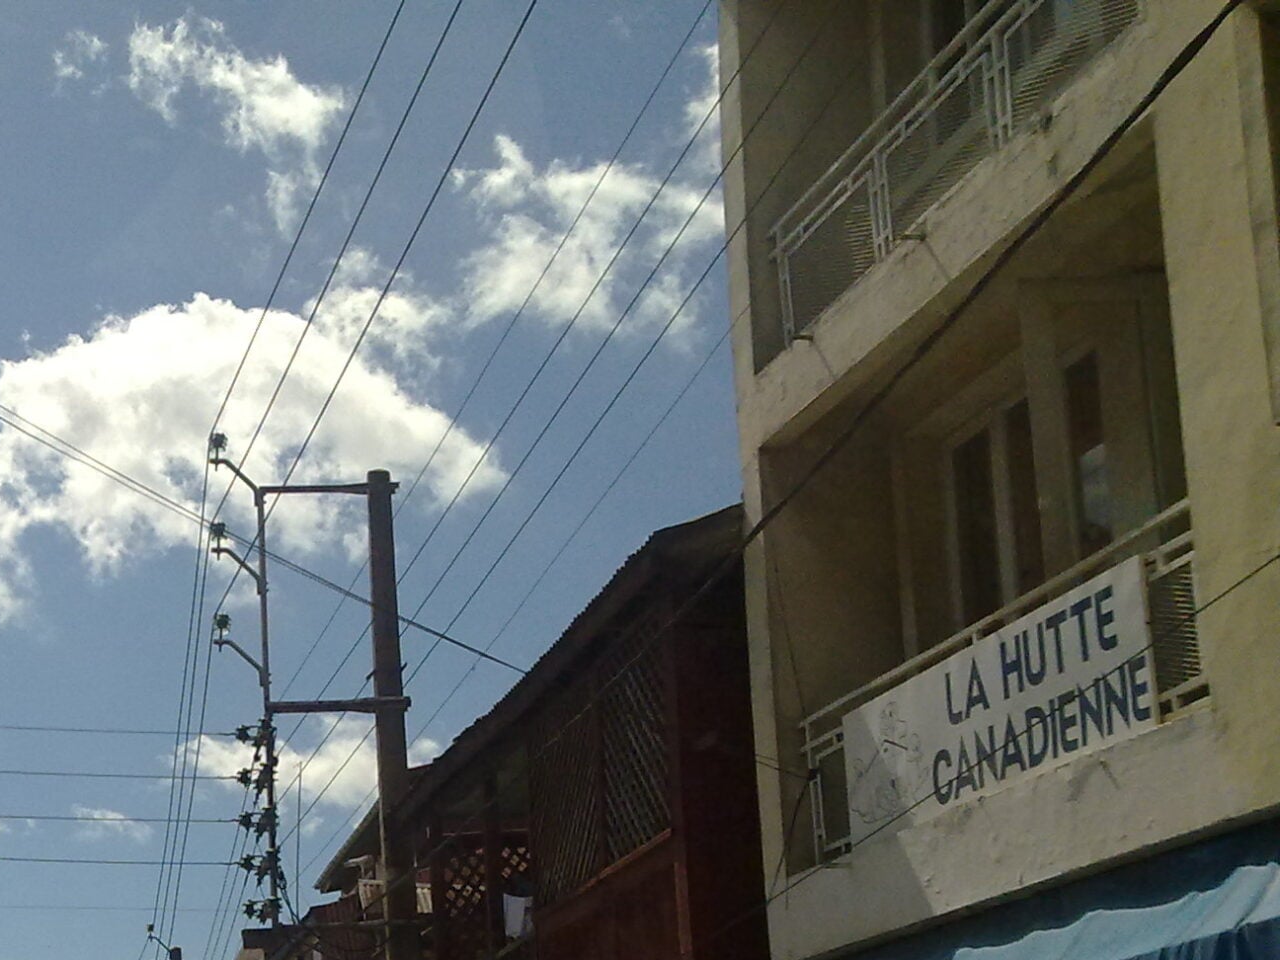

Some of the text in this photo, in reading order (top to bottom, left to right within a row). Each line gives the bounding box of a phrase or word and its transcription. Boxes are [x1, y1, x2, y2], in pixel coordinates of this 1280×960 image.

[944, 584, 1118, 725] LA HUTTE
[931, 654, 1151, 805] CANADIENNE
